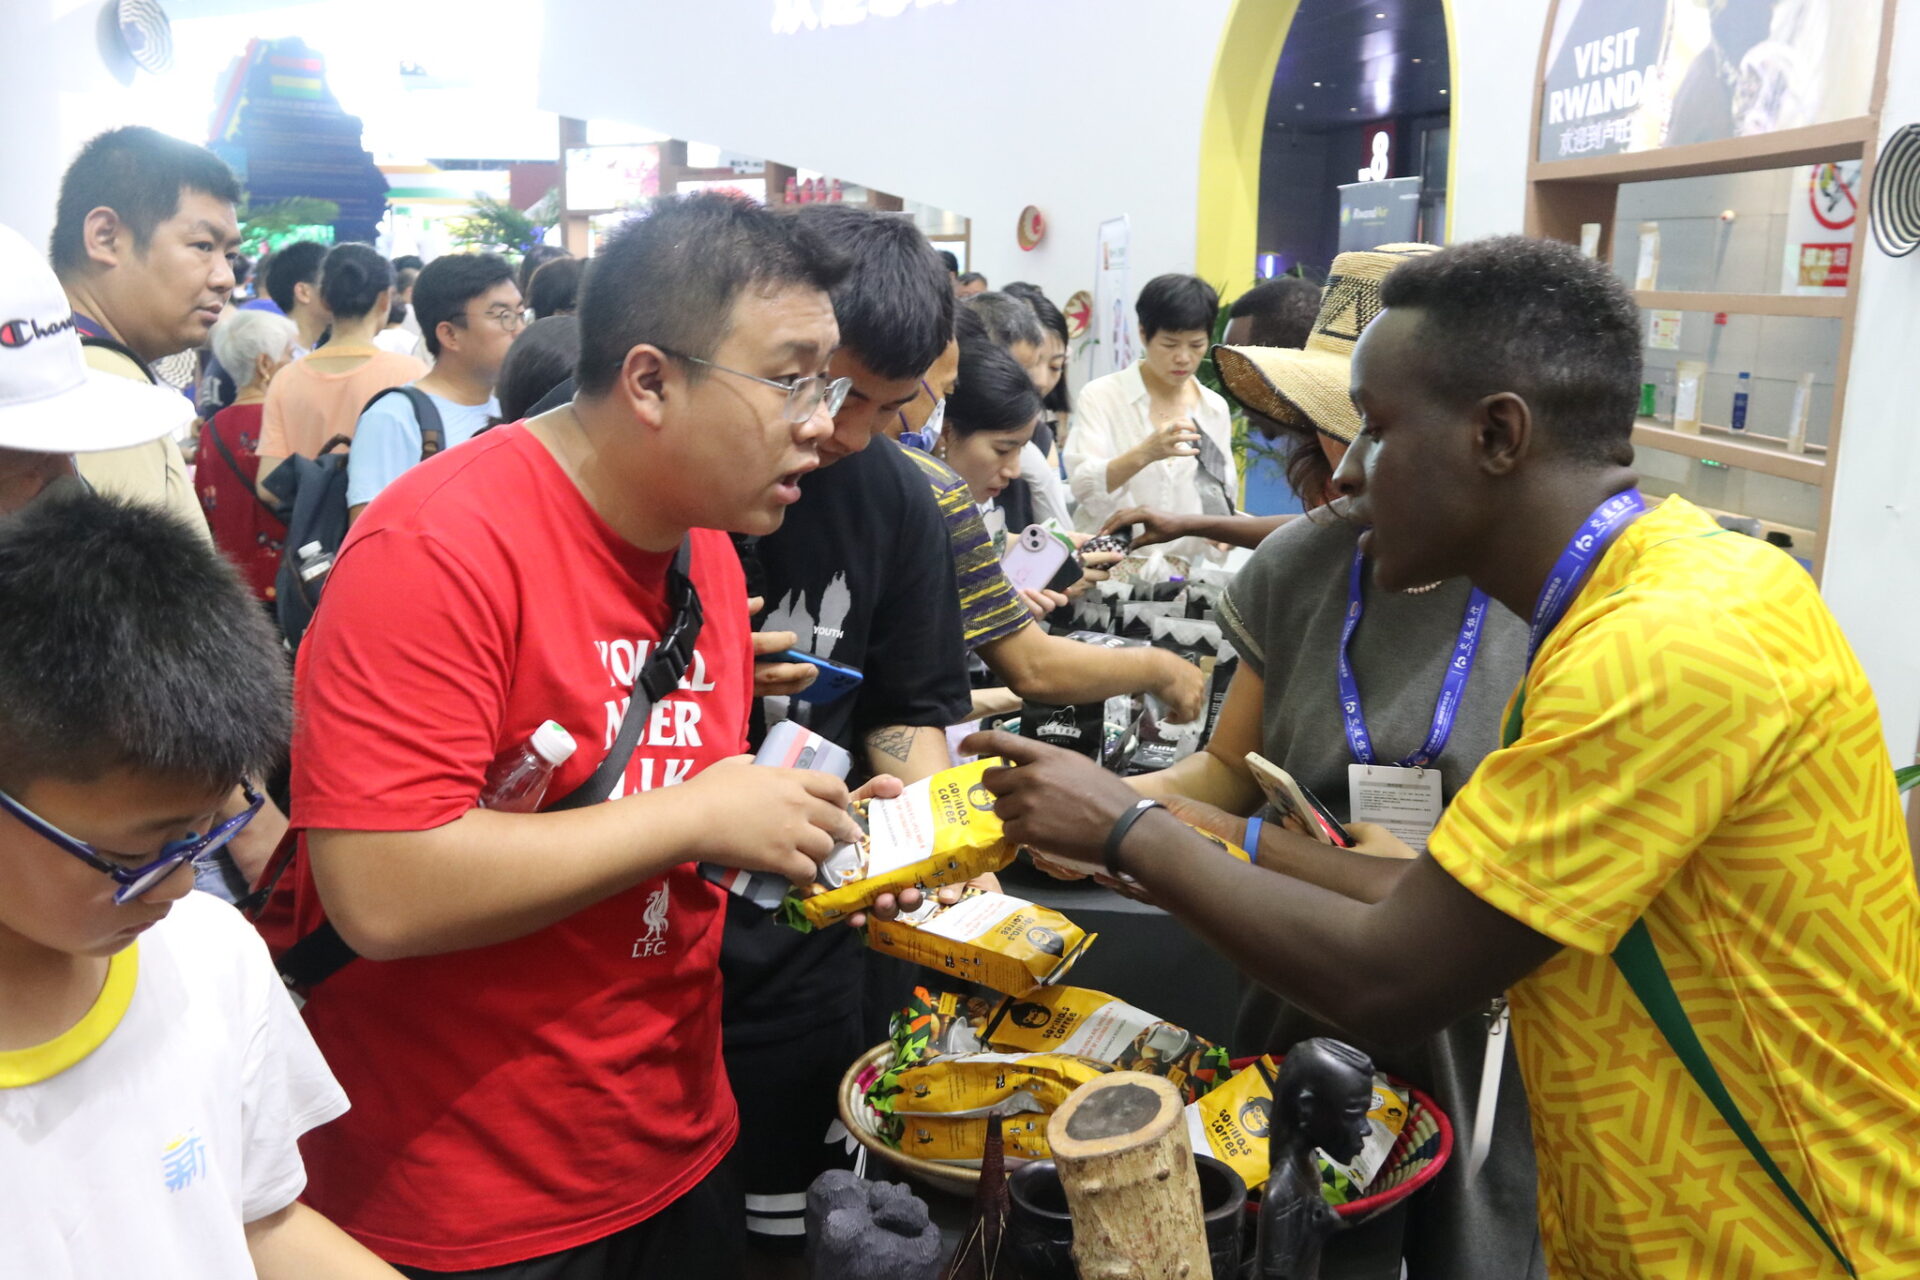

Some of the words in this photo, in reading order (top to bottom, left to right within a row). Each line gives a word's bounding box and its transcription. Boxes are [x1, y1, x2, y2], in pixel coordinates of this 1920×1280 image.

[1574, 26, 1640, 79] VISIT
[1371, 131, 1389, 182] 8
[813, 626, 845, 639] YOUTH
[604, 697, 703, 748] NER
[632, 941, 666, 958] L.F.C.
